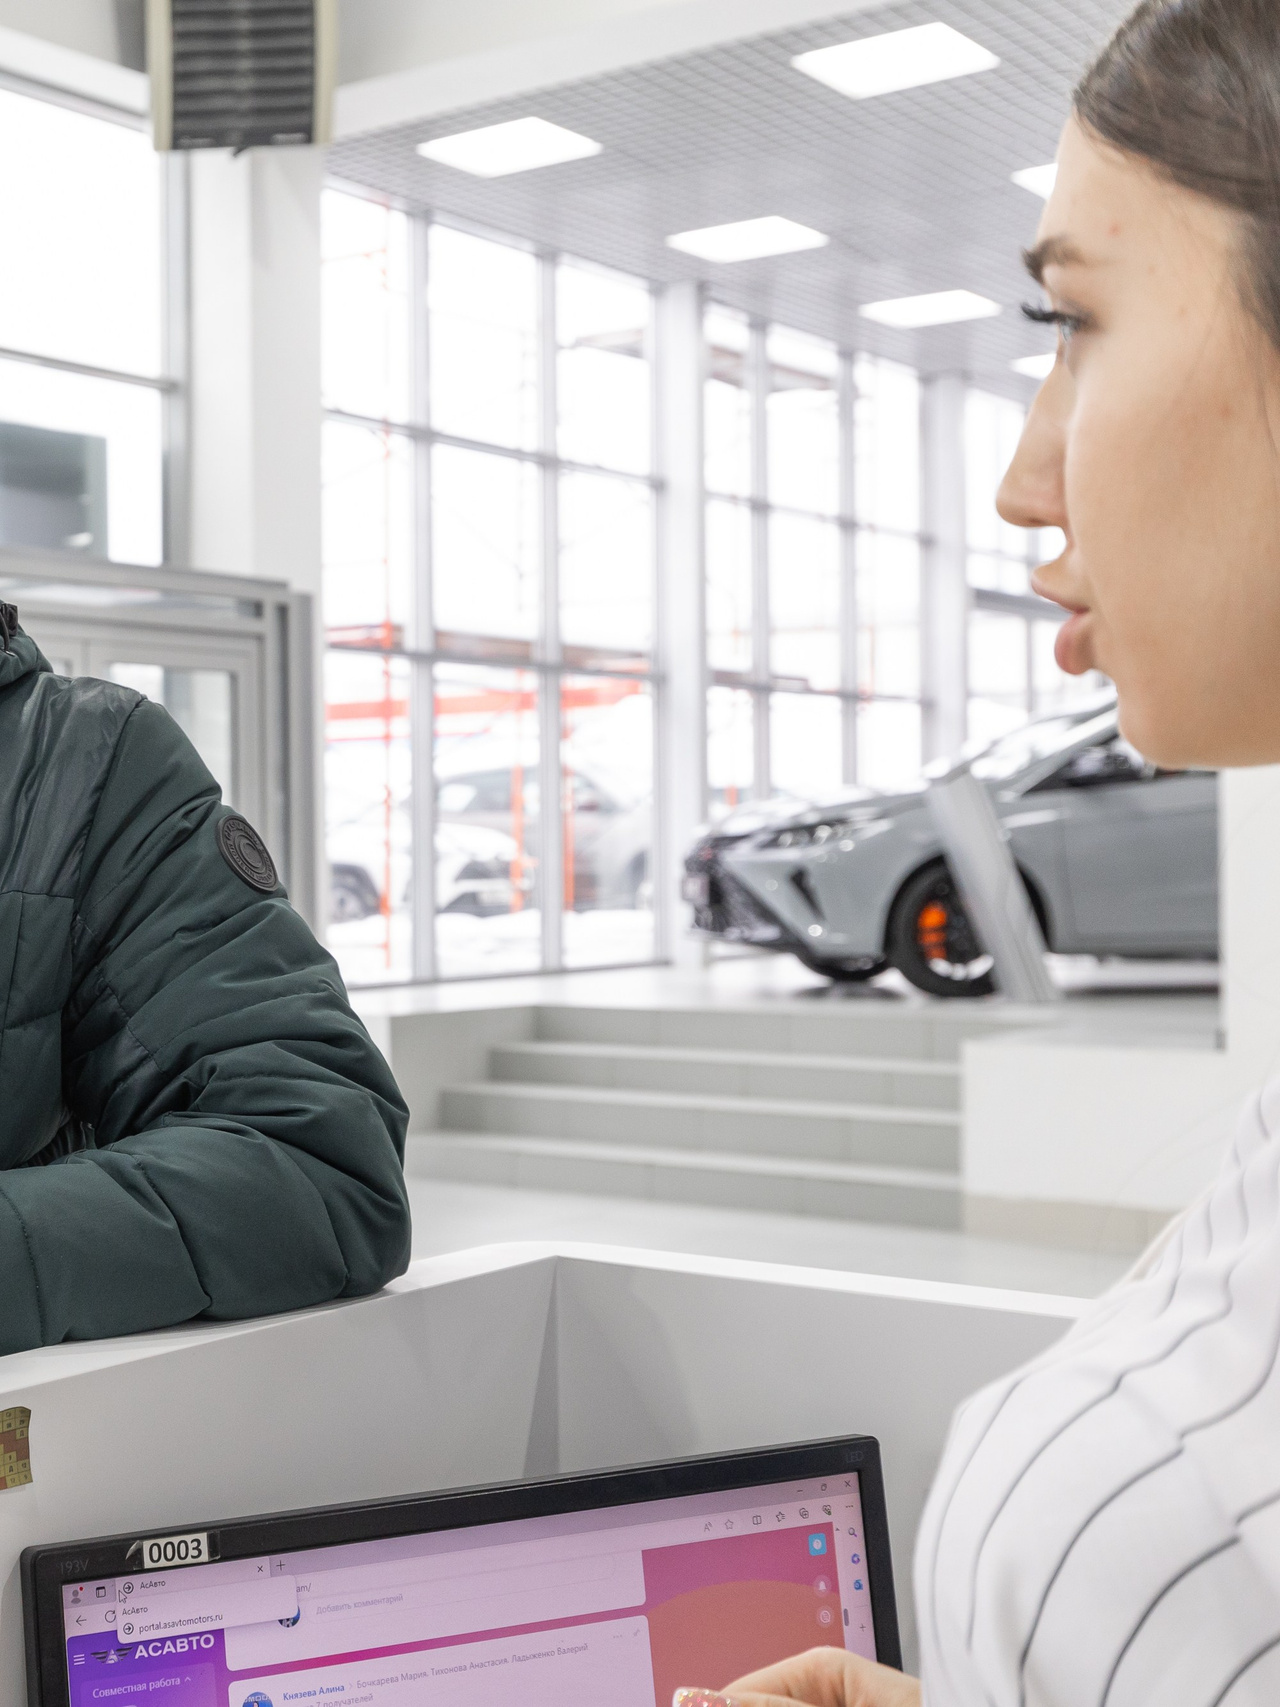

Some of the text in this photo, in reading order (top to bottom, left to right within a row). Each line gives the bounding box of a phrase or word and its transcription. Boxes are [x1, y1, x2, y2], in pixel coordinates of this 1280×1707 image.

[149, 1538, 202, 1564] 0003
[59, 1558, 89, 1575] 193V
[140, 1580, 166, 1590] АсАвто
[122, 1606, 148, 1616] АсАвто
[316, 1594, 404, 1615] Добавить комментарий
[138, 1614, 223, 1634] portal.asavtomotors.ru
[134, 1634, 215, 1660] АСАВТО
[283, 1690, 317, 1701] Князева
[318, 1684, 345, 1695] Алина
[356, 1676, 399, 1689] Бочкарева
[431, 1664, 467, 1676] Тихонова
[511, 1650, 555, 1664] Ладыженко
[557, 1643, 589, 1656] Валерий
[92, 1677, 180, 1699] Совместная работа
[323, 1693, 373, 1707] получателей
